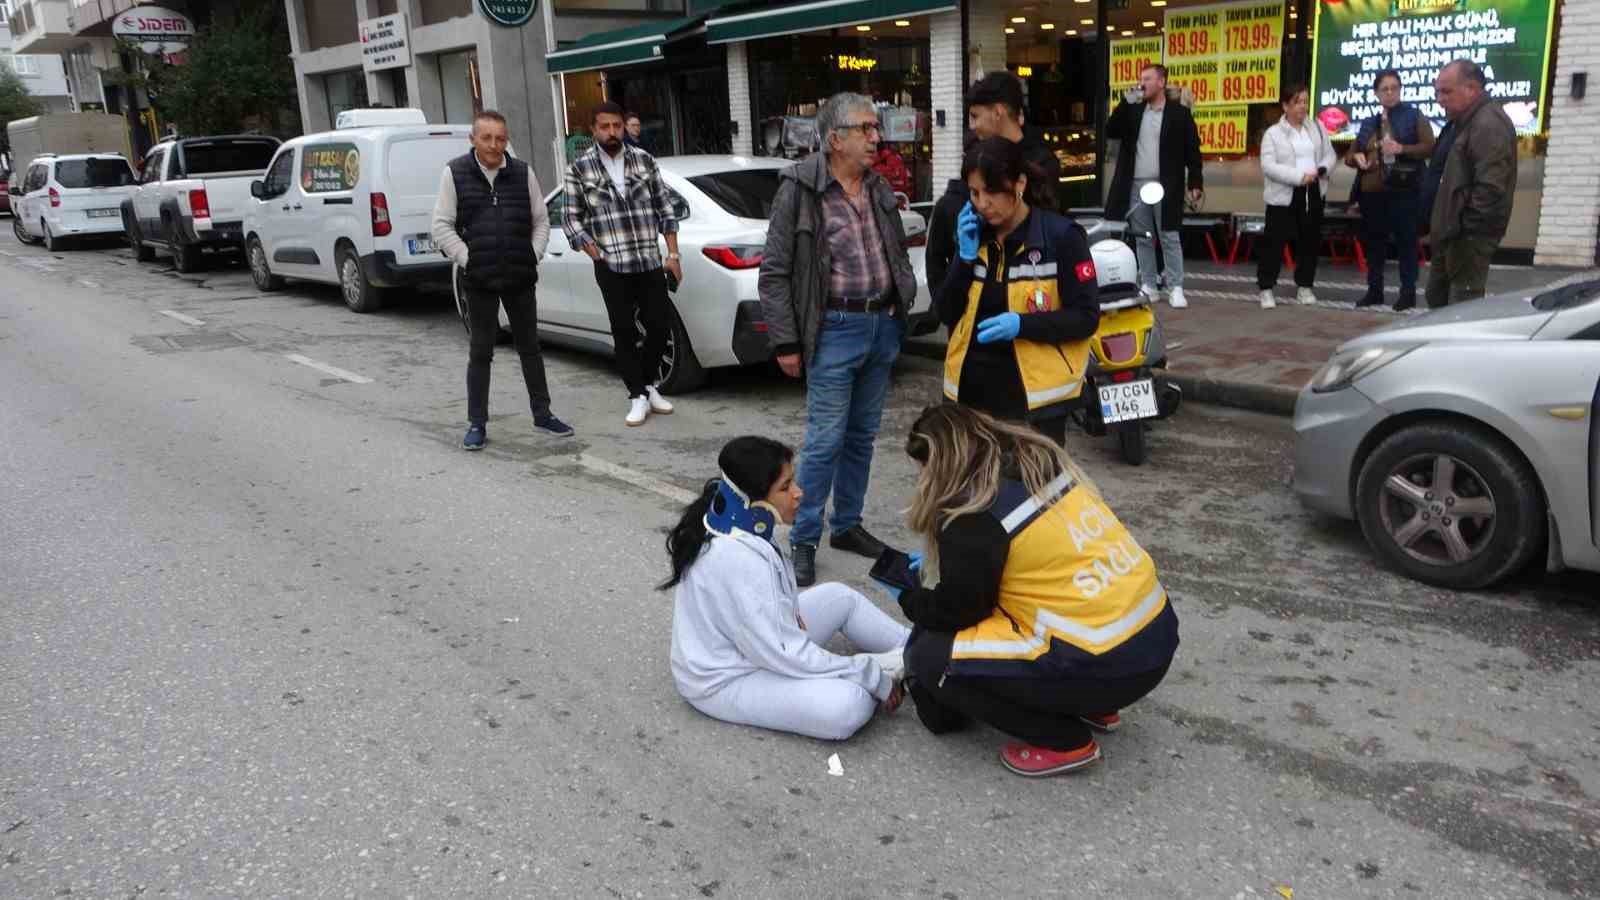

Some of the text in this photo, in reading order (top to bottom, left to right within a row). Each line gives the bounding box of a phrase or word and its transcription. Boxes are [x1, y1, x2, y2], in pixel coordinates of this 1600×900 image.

[1352, 23, 1378, 38] HER
[1413, 15, 1452, 31] HALK
[1226, 58, 1276, 73] TÜM PİLİÇ
[1362, 55, 1390, 71] DEV
[1321, 88, 1365, 105] BÜYÜK
[1101, 383, 1149, 401] 07 CGV
[1115, 399, 1140, 414] 146
